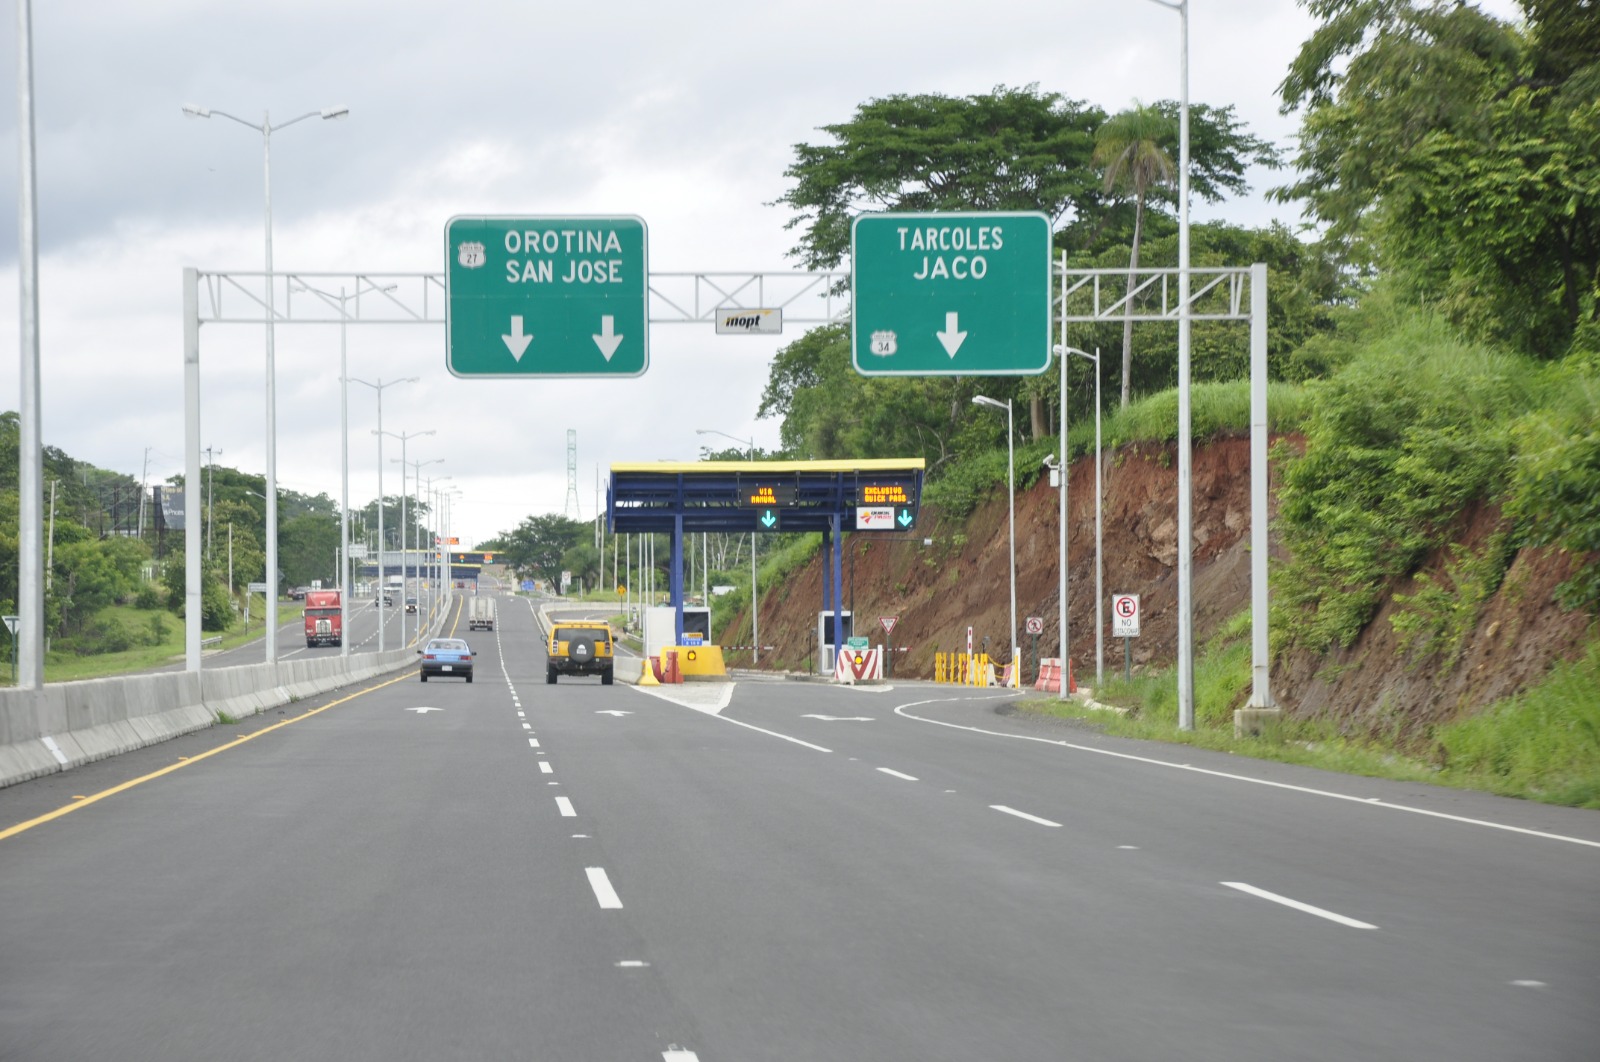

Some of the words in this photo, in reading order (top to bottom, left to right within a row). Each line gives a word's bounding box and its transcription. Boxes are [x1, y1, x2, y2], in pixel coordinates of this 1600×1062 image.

[504, 230, 623, 254] OROTINA
[897, 227, 1003, 251] TARCOLES
[467, 254, 477, 264] 27
[506, 259, 554, 283] SAN
[562, 259, 623, 283] JOSE
[913, 255, 987, 280] JACO
[878, 342, 889, 352] 34
[864, 486, 903, 495] EXCLUSIVO
[751, 496, 776, 504] MANUAL
[1121, 618, 1132, 626] NO
